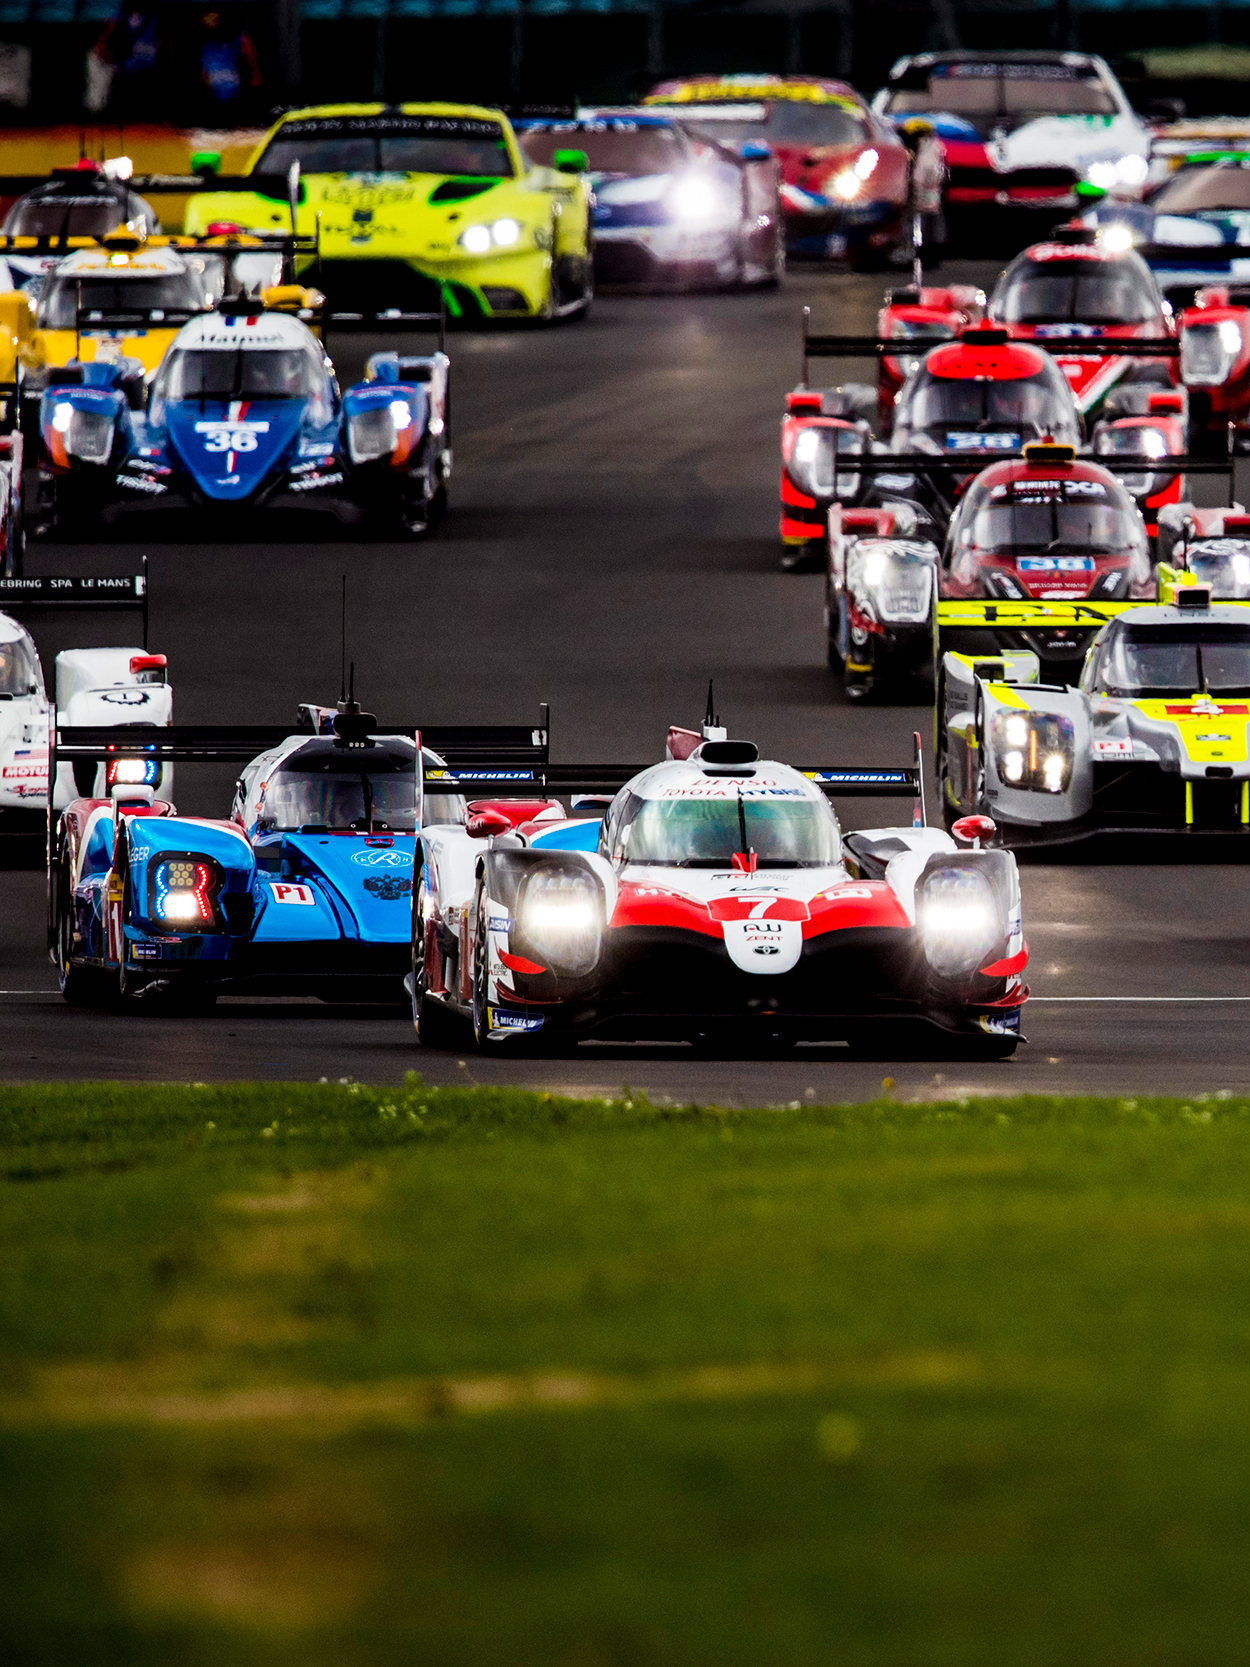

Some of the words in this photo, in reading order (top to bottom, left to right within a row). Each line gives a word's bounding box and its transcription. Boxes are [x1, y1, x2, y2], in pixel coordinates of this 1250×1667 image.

[204, 431, 258, 452] 36
[50, 579, 74, 588] SPA
[81, 579, 95, 588] LE
[97, 578, 132, 588] MANS
[4, 766, 49, 777] MOTU
[662, 788, 727, 797] TOYOTA
[275, 885, 307, 901] P1
[738, 897, 777, 919] 7
